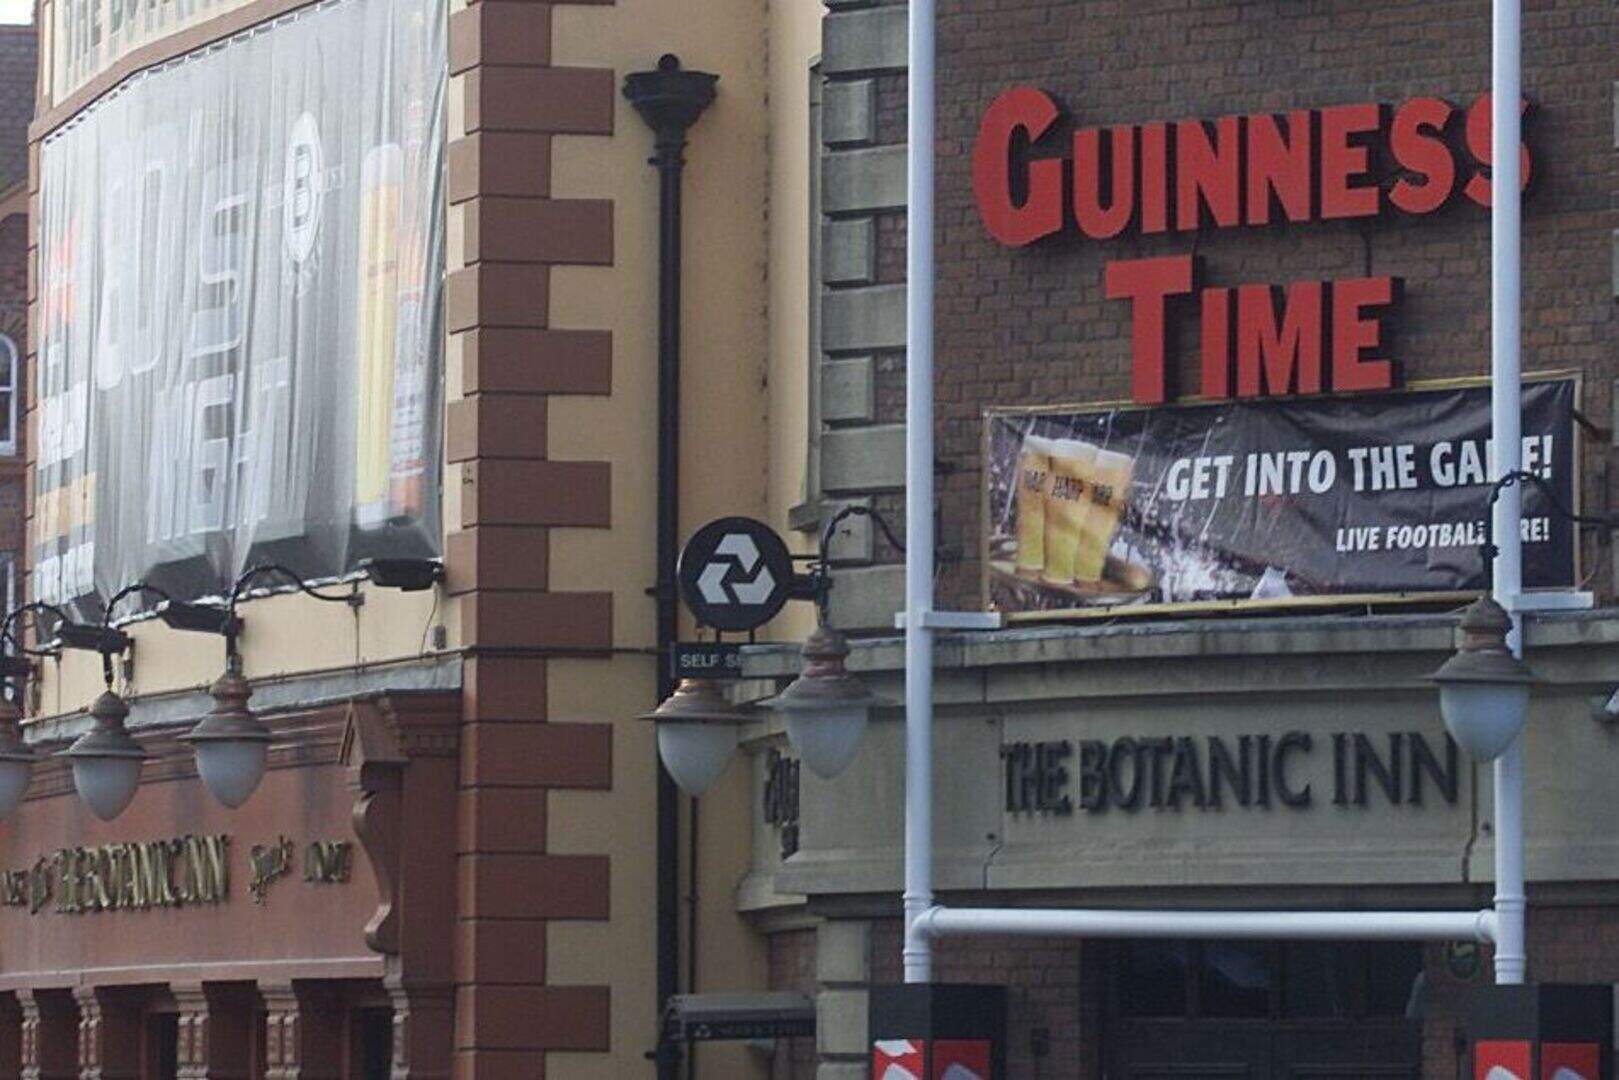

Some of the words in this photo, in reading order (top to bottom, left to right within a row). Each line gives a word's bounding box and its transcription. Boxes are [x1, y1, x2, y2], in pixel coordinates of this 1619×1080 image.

[972, 85, 1532, 247] GUINNESS
[1106, 254, 1392, 404] TIME
[1166, 454, 1233, 502] GET
[1246, 450, 1336, 497] INTO
[1348, 444, 1418, 492] THE
[1335, 525, 1379, 554] LIVE
[1386, 521, 1487, 549] FOOTBALL
[680, 654, 720, 667] SELF
[1000, 739, 1072, 815] THE
[1078, 730, 1312, 813] BOTANIC
[1332, 731, 1460, 808] INN
